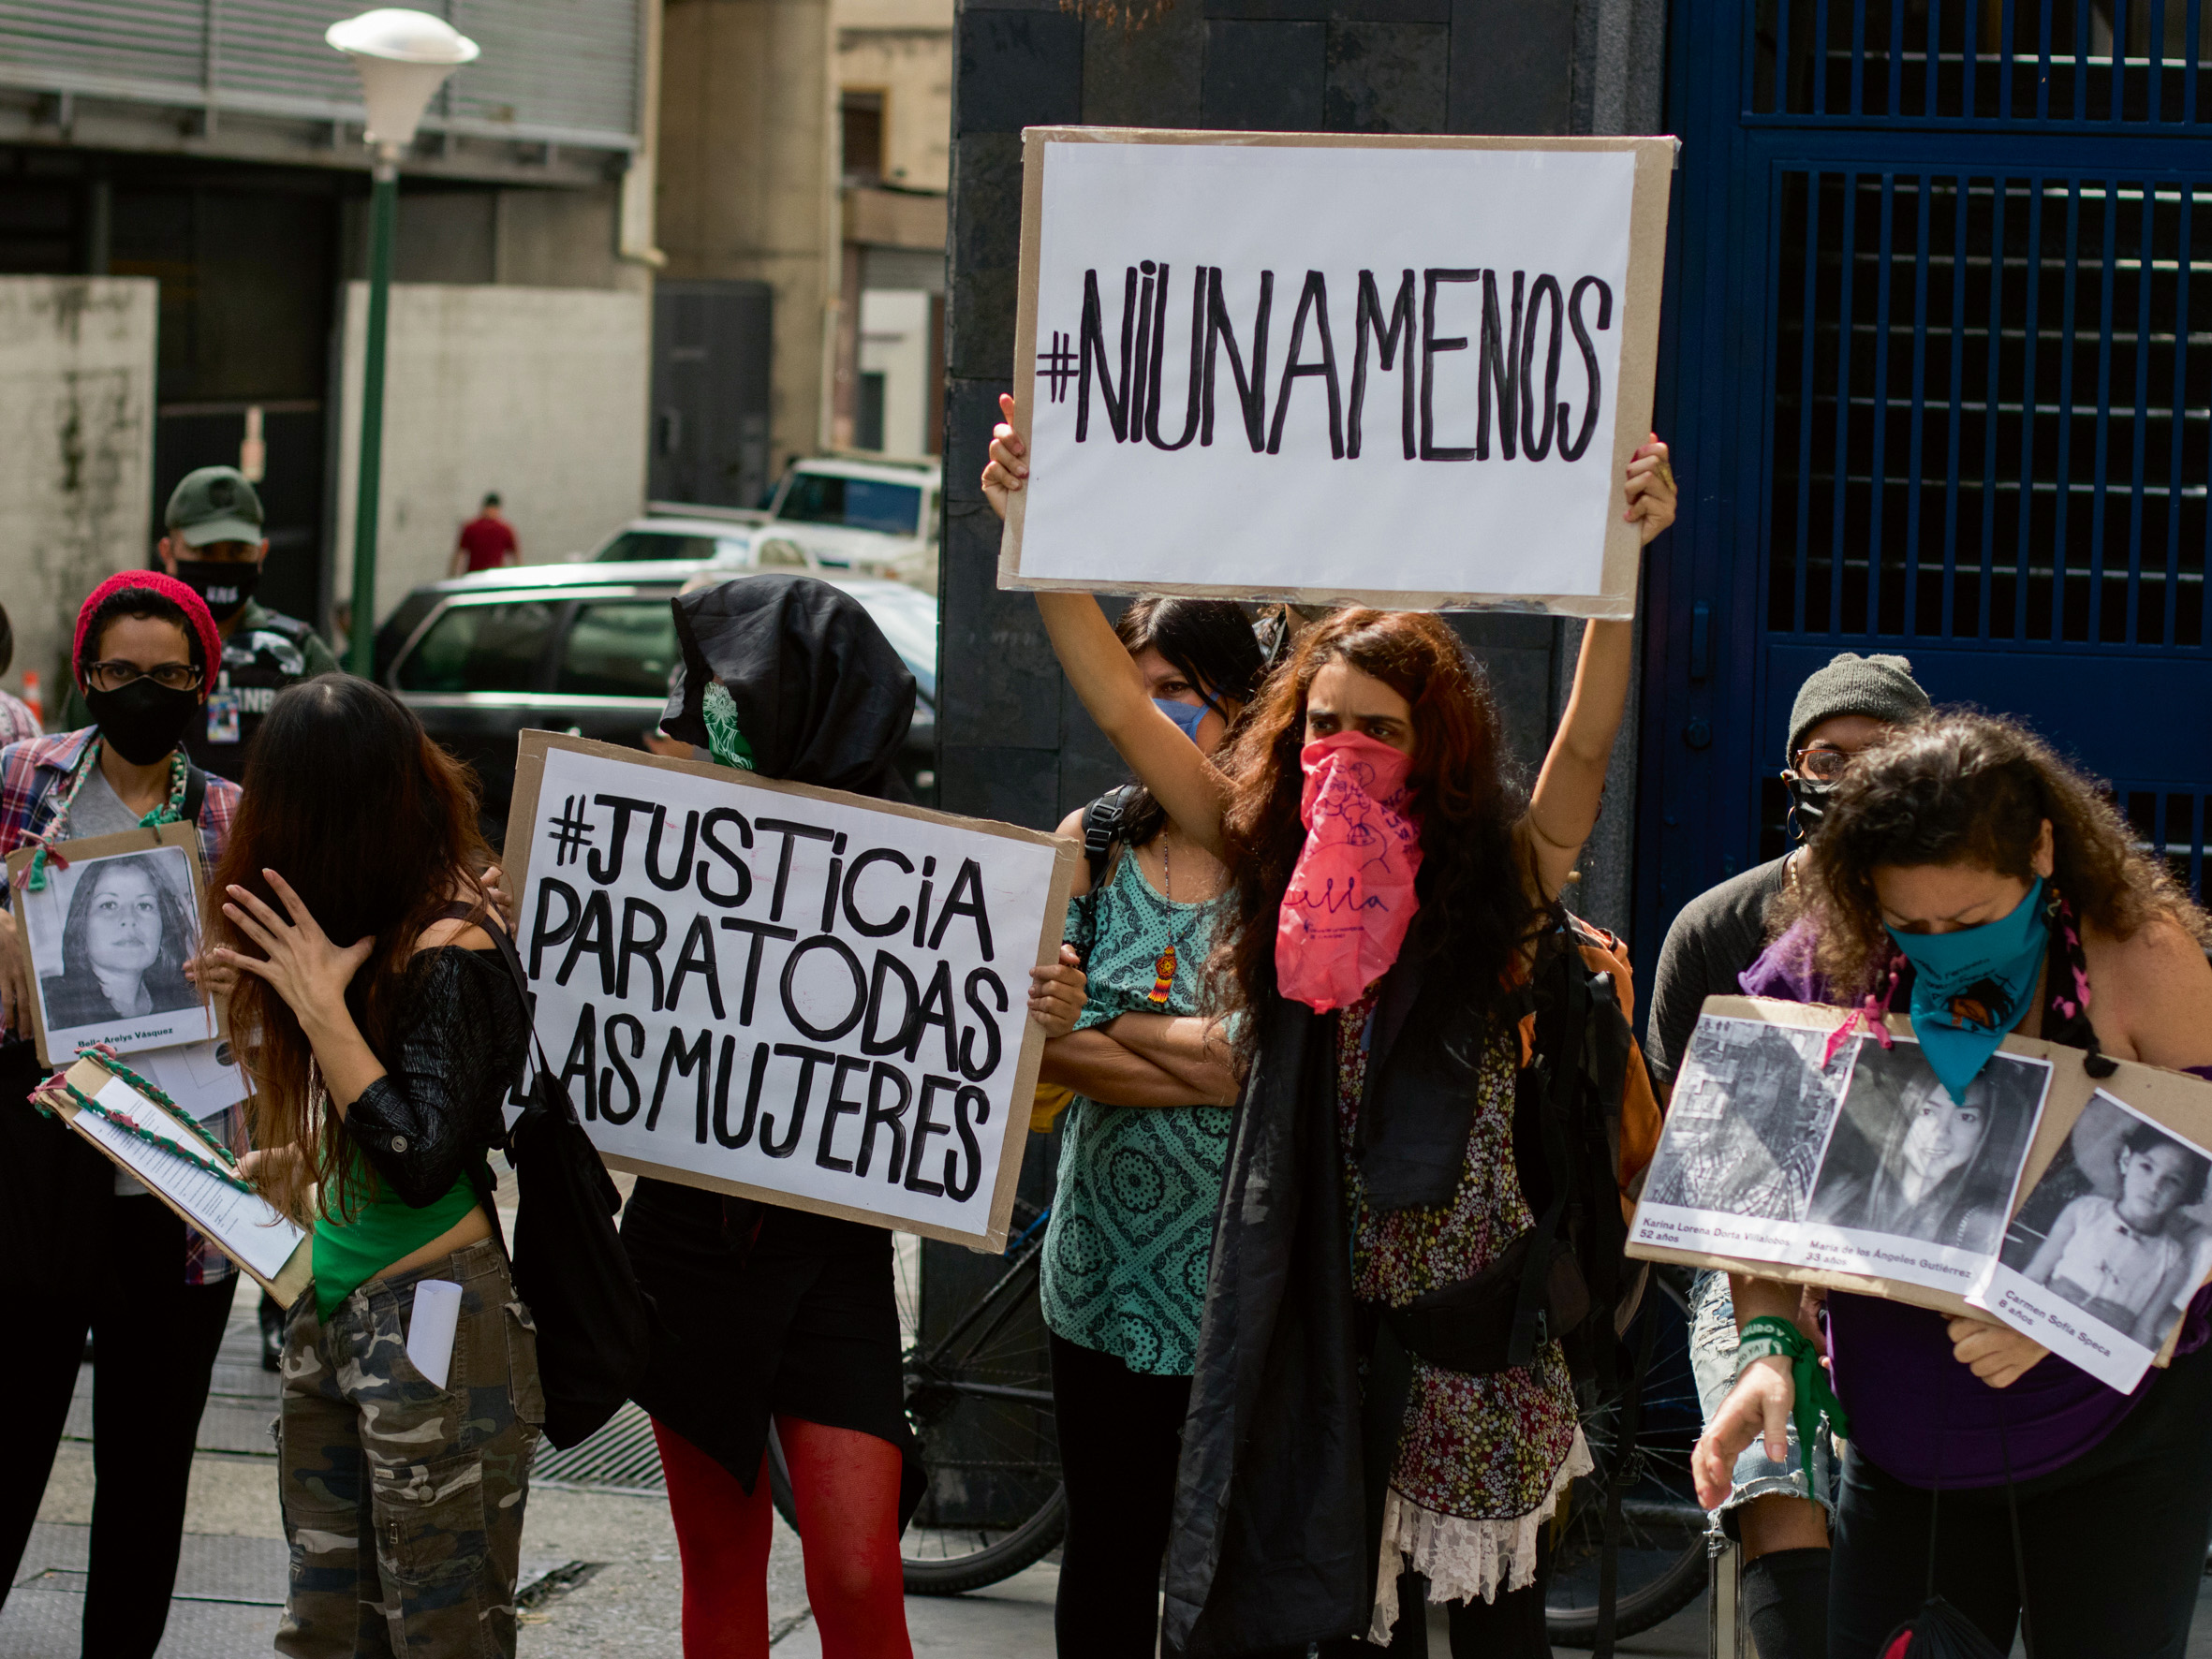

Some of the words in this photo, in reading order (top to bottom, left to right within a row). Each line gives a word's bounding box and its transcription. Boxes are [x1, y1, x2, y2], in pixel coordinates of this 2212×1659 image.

[1284, 876, 1389, 913] ella
[104, 1035, 132, 1044] Arelys
[135, 1028, 173, 1039] Vásquez
[1640, 1229, 1653, 1239] 52
[1656, 1231, 1679, 1242] años
[1643, 1217, 1674, 1230] Karina
[1677, 1223, 1710, 1236] Lorena
[1714, 1228, 1740, 1240] Dorta
[1745, 1232, 1791, 1246] Villalobos
[1806, 1252, 1821, 1261] 33
[1823, 1254, 1847, 1266] años
[1842, 1244, 1853, 1255] de
[1856, 1246, 1870, 1257] los
[1873, 1248, 1916, 1266] Ángeles
[1920, 1258, 1972, 1278] Gutiérrez
[1998, 1299, 2008, 1308] 8
[2008, 1308, 2034, 1326] años
[2005, 1290, 2046, 1318] Carmen
[2077, 1331, 2111, 1358] Speca
